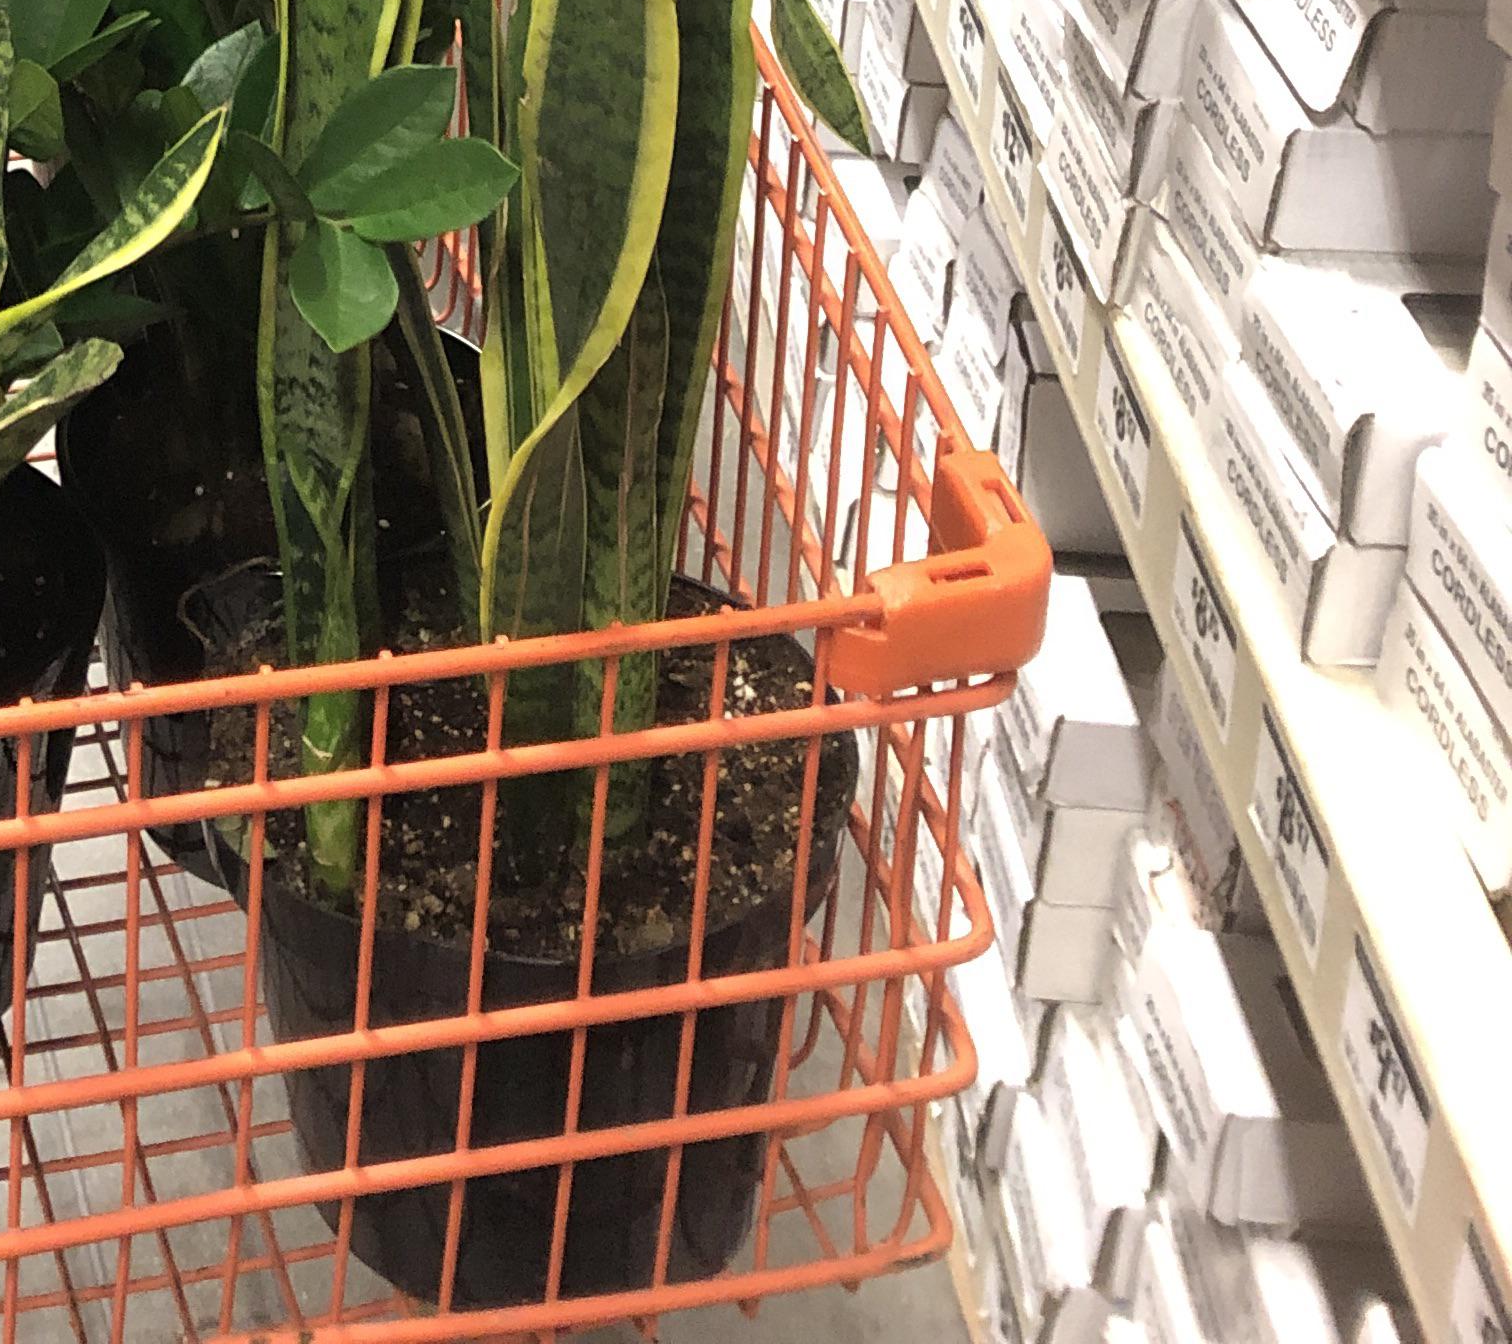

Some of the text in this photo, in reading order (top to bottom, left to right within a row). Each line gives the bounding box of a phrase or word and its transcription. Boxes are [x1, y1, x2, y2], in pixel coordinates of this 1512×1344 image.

[1196, 77, 1251, 183] CORDLESS
[1058, 151, 1102, 250] CORDLESS
[1174, 189, 1230, 296] CORDLESS
[1144, 302, 1197, 418] CORDLESS
[1432, 548, 1512, 690] CORDLESS
[1406, 666, 1488, 822] CORDLESS
